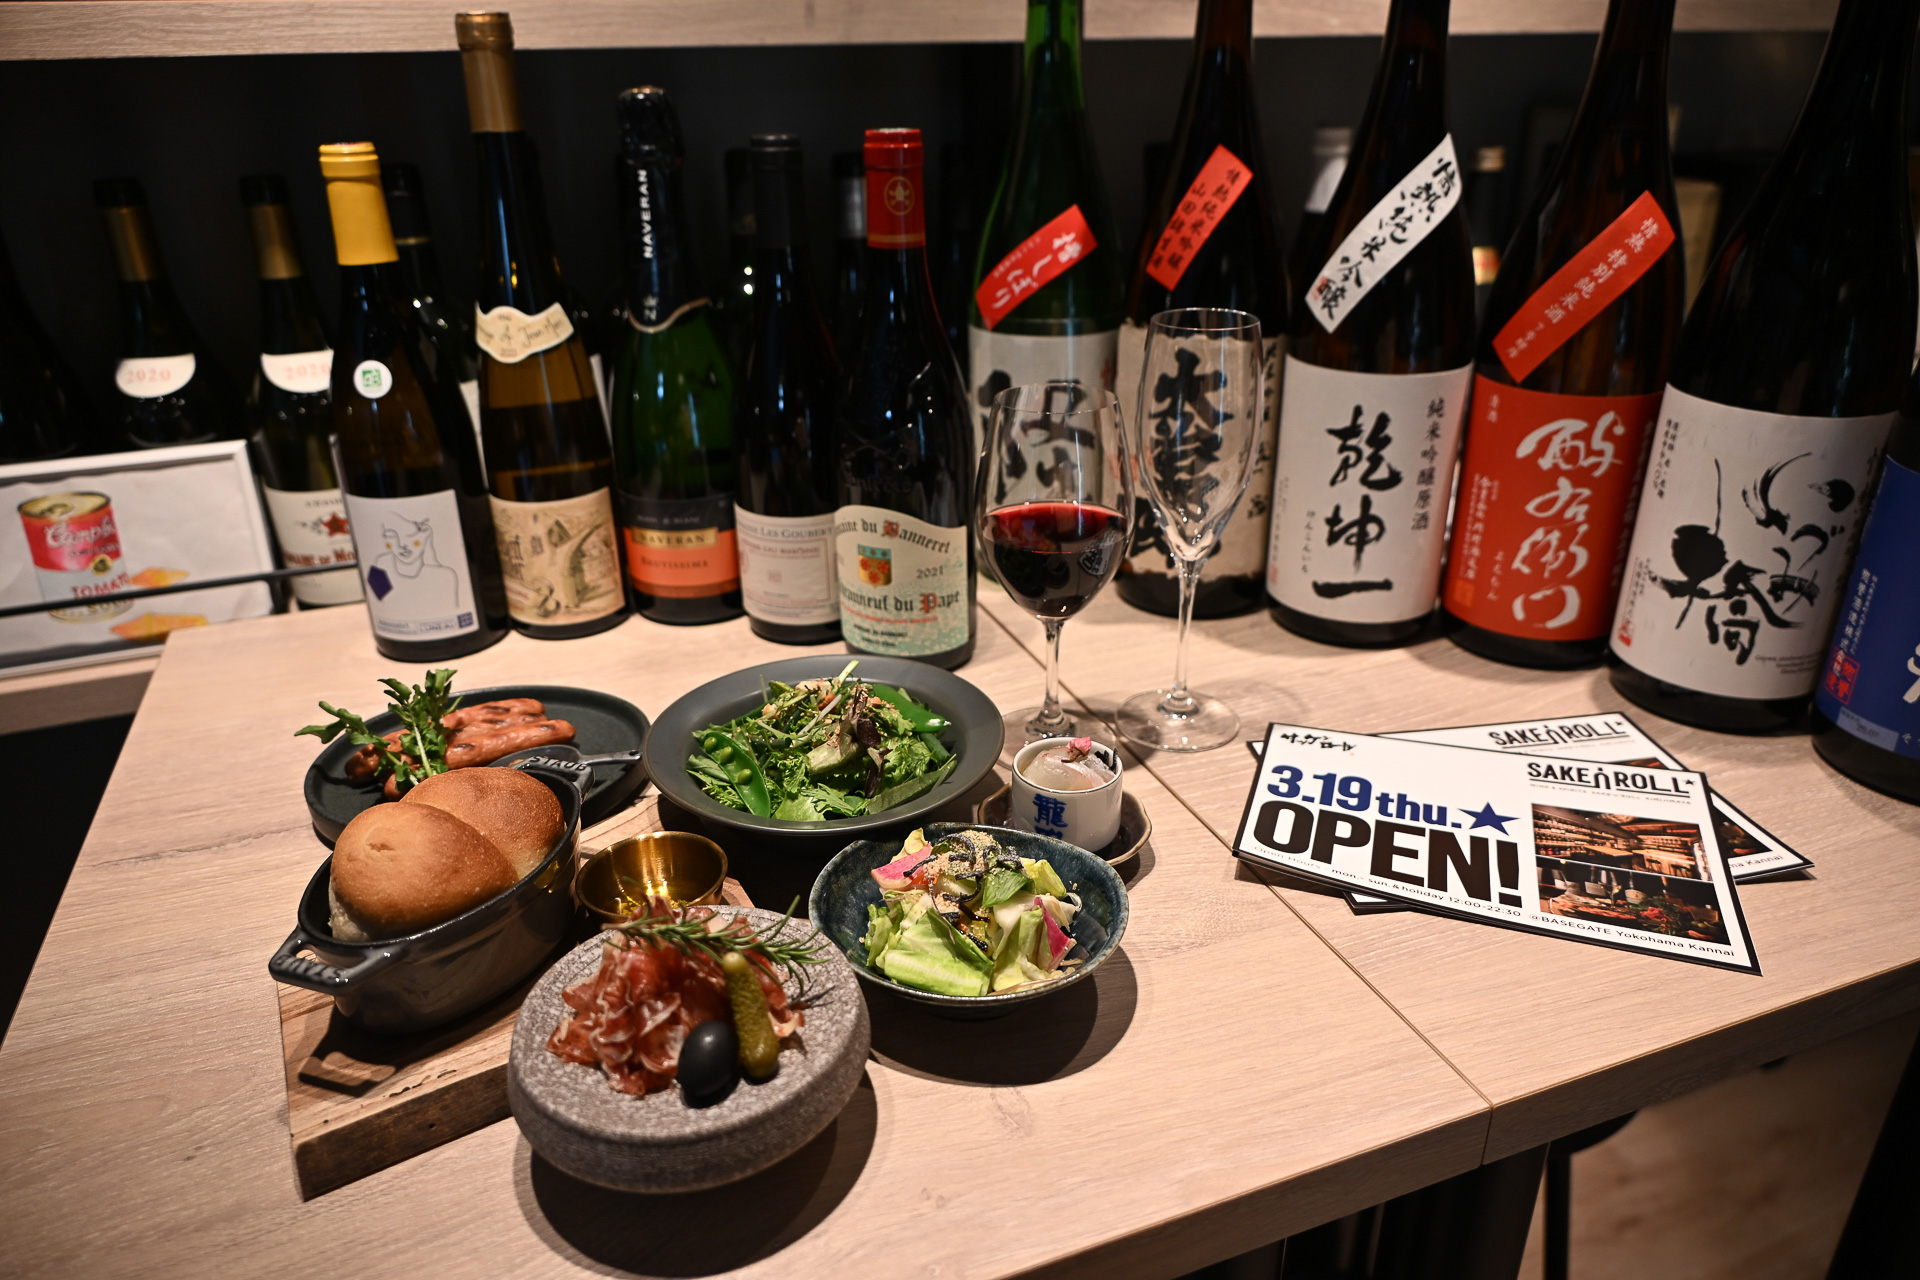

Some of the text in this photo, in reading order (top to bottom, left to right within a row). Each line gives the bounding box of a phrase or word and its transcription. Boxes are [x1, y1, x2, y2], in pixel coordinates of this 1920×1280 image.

[637, 168, 654, 259] NAVERAN
[1311, 403, 1403, 600] 乾坤一
[861, 518, 878, 533] du
[640, 534, 706, 546] NAVERAN
[916, 565, 943, 579] 2021
[894, 596, 914, 612] du
[919, 591, 960, 614] Pape
[530, 755, 588, 772] STAUB
[1254, 800, 1523, 909] OPEN!
[1745, 854, 1784, 866] Kannai
[1254, 846, 1284, 860] Open
[1288, 856, 1321, 869] Hours
[1449, 896, 1521, 917] 12:00-22:30
[1529, 914, 1735, 957] @BASEGATE Yokohama Kannai
